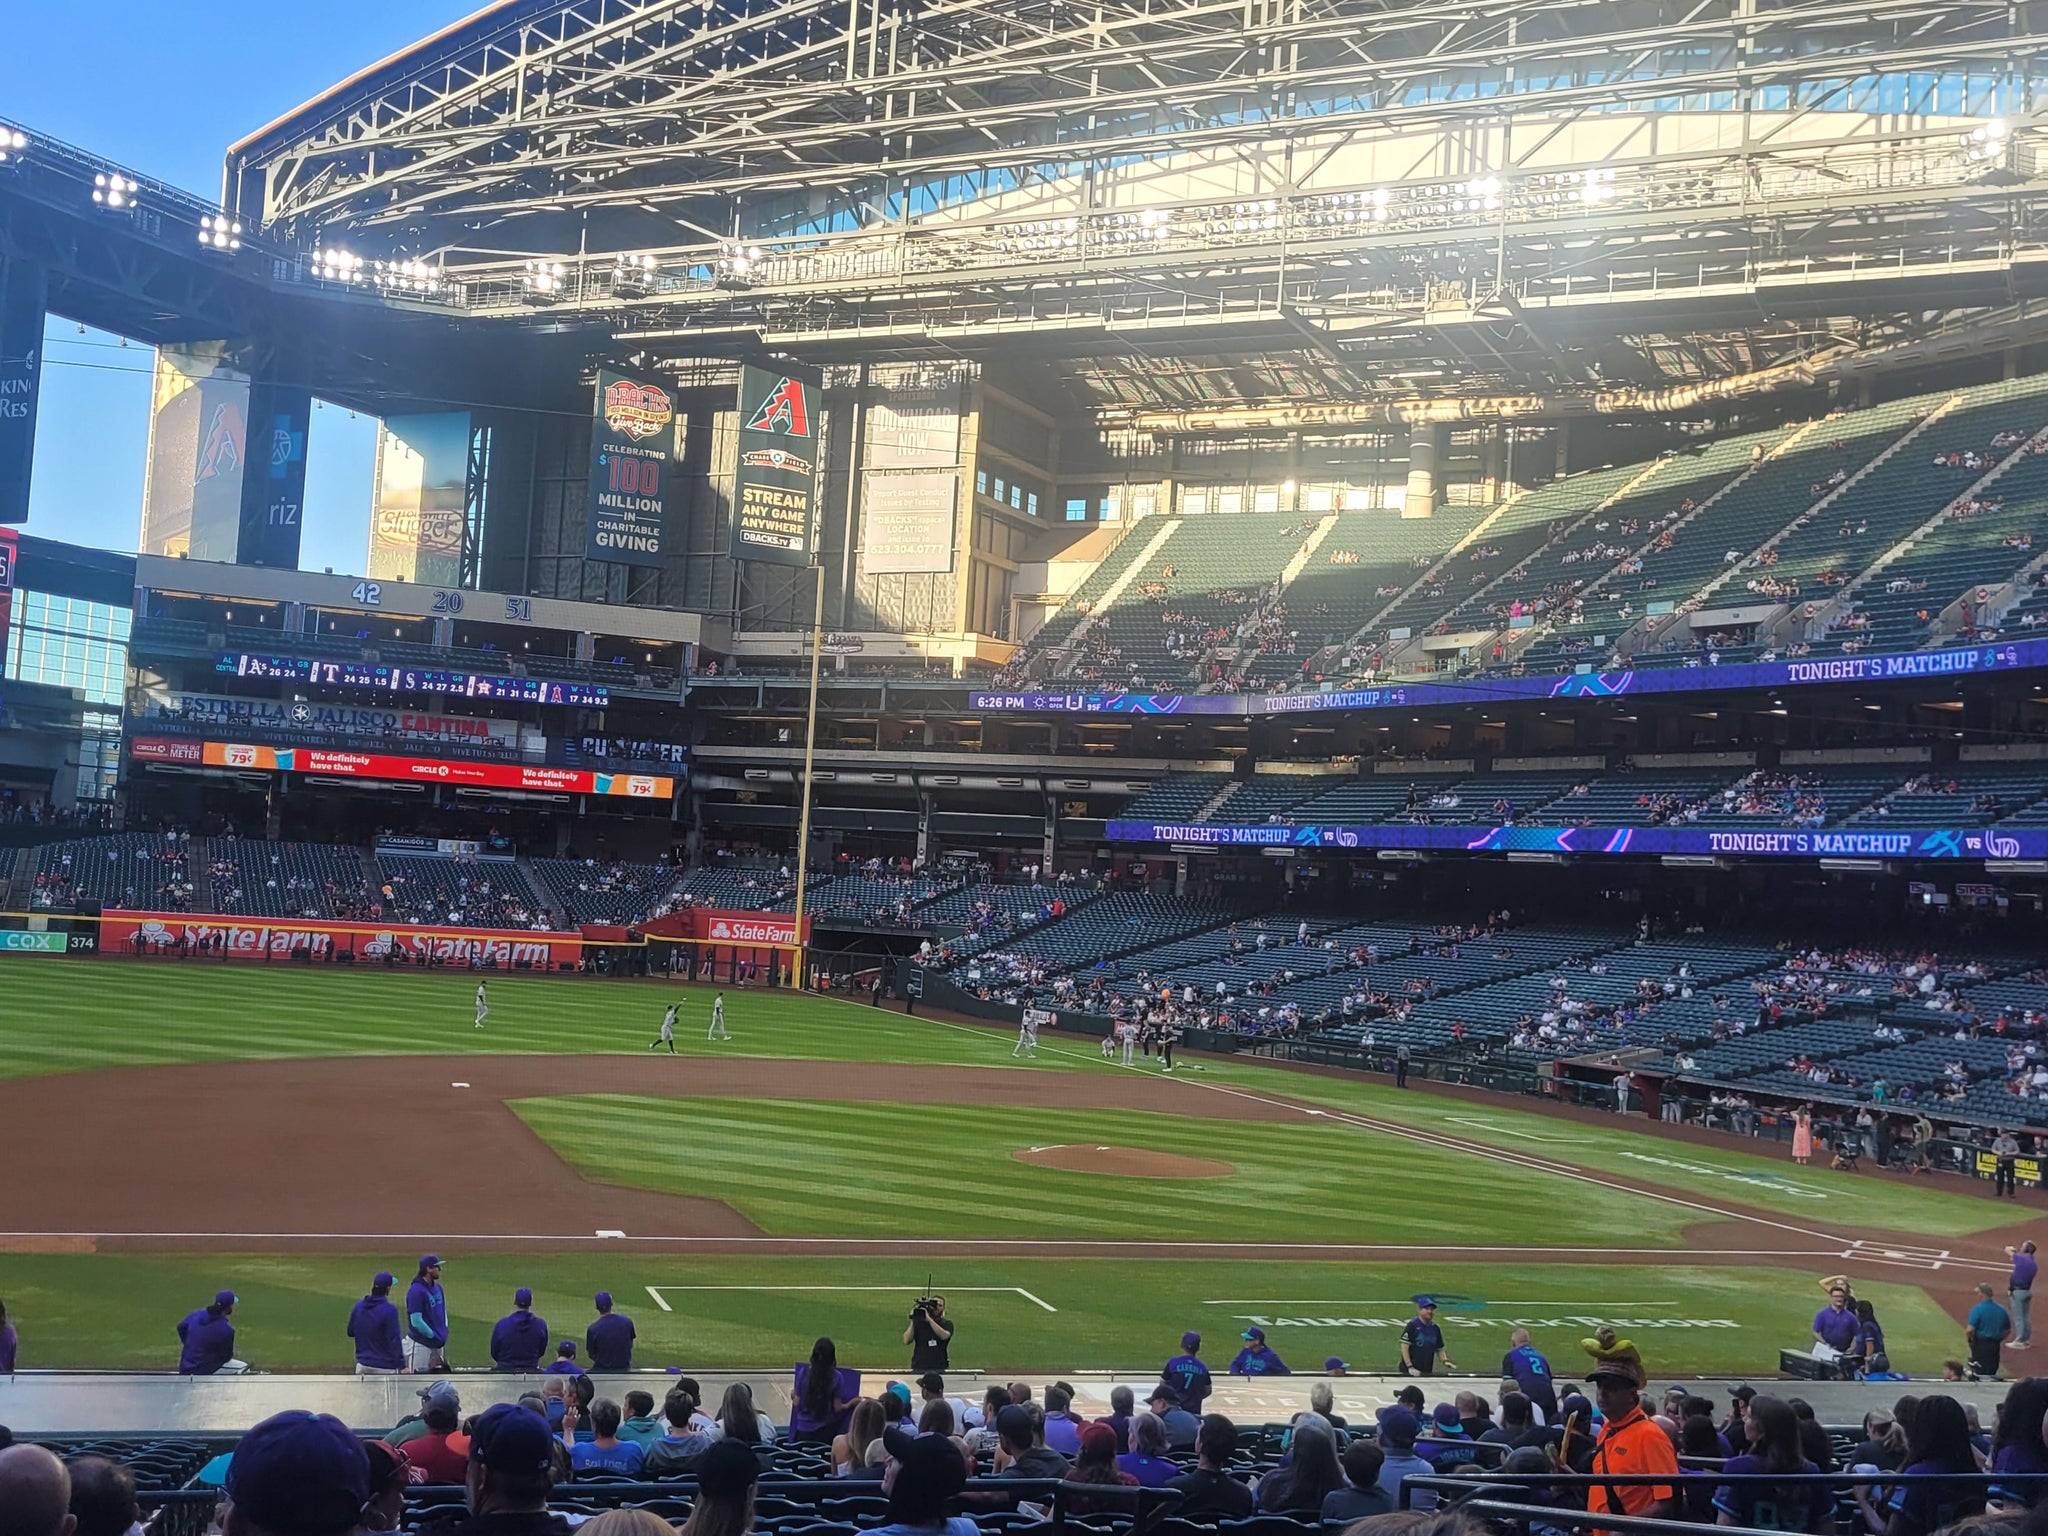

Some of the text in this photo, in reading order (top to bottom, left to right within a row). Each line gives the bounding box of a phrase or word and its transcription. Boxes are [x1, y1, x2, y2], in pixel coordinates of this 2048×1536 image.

[603, 444, 666, 460] CELEBRATING
[898, 432, 928, 457] NOW
[600, 454, 660, 497] $100
[598, 493, 662, 513] MILLION
[742, 488, 807, 510] STREAM
[269, 497, 297, 525] riz
[624, 511, 636, 522] IN
[741, 504, 805, 523] ANY GAME
[381, 511, 455, 544] Slugger
[597, 520, 660, 536] CHARITABLE
[741, 516, 805, 535] ANYWHERE
[887, 525, 929, 533] LOCATION
[595, 531, 659, 553] GIVING
[871, 544, 944, 554] 623.304.0777
[352, 581, 382, 605] 42
[431, 591, 463, 613] 20
[505, 597, 531, 621] 51
[222, 656, 233, 664] AL
[1787, 651, 1978, 681] TONIGHT'S MATCHUP
[269, 668, 296, 678] 26 24
[344, 674, 356, 683] 24
[358, 676, 370, 684] 25
[374, 677, 387, 686] 1.5
[421, 681, 434, 690] 24
[436, 683, 447, 691] 27
[450, 684, 464, 693] 2.5
[496, 688, 505, 696] 21
[510, 689, 519, 698] 31
[523, 690, 537, 699] 6.0
[569, 695, 608, 705] 17 34 9.5
[977, 697, 1024, 709] 6:26 PM
[1265, 691, 1380, 711] TONIGHT'S MATCHUP
[181, 695, 489, 738] ESTRELLA JALISCO CANTINA
[169, 749, 200, 760] METER
[310, 752, 370, 766] We definitely
[310, 762, 355, 772] have that.
[412, 765, 437, 774] CIRCLE
[522, 778, 564, 788] have that.
[523, 769, 578, 782] We definitely
[1153, 826, 1229, 842] TONIGHT'S
[1232, 828, 1290, 843] MATCHUP
[1710, 833, 1808, 851] TONIGHT'S
[1813, 834, 1911, 853] MATCHUP
[1957, 886, 1993, 895] STREE
[7, 932, 51, 949] COX
[71, 932, 95, 949] 374
[1232, 1314, 1741, 1328] TALKIN STICK RESORT
[1529, 1357, 1543, 1375] 2
[1184, 1372, 1193, 1390] 7
[1223, 1396, 1367, 1409] FIED
[604, 1458, 627, 1471] Friend
